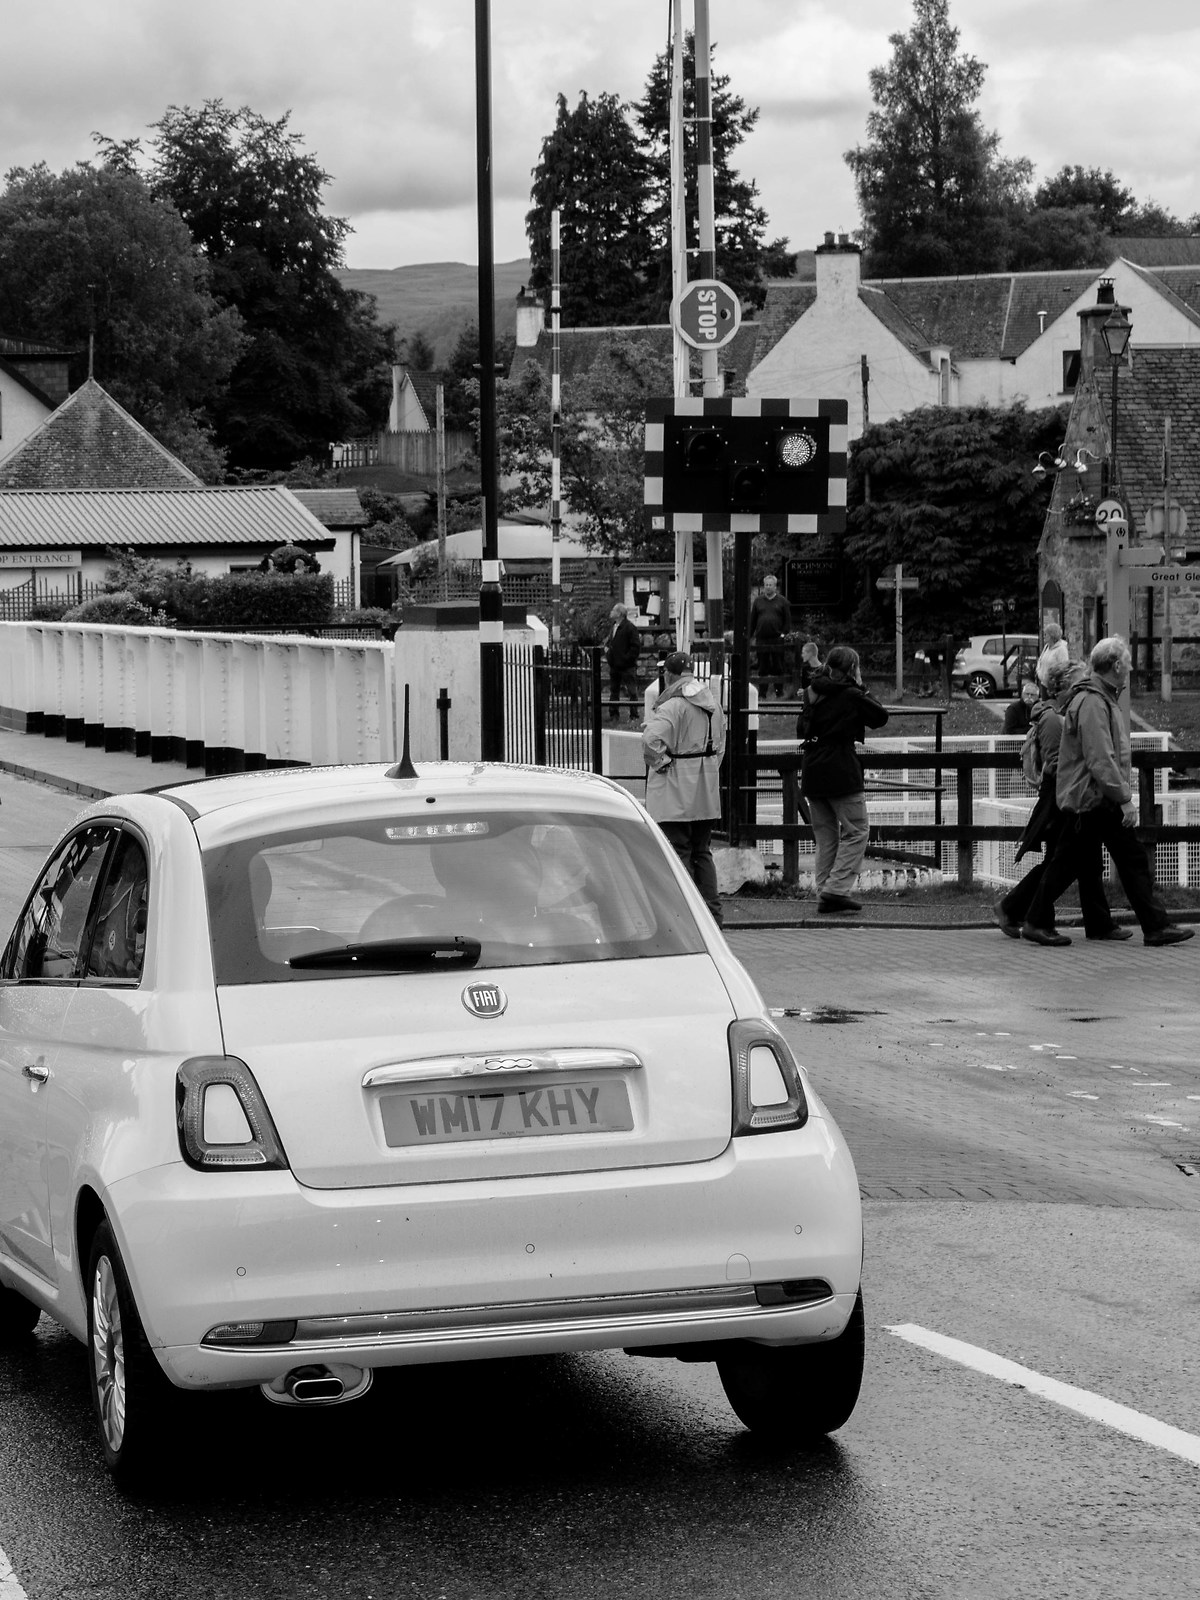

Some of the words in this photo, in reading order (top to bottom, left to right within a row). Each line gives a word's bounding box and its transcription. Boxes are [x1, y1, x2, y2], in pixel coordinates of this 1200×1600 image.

[697, 290, 717, 340] STOP
[1097, 508, 1122, 525] 20
[12, 554, 74, 564] ENTRANCE
[1151, 572, 1179, 581] Great
[472, 989, 498, 1008] FIAT
[484, 1057, 532, 1071] 500
[409, 1093, 505, 1136] WM17
[518, 1087, 600, 1128] KHY
